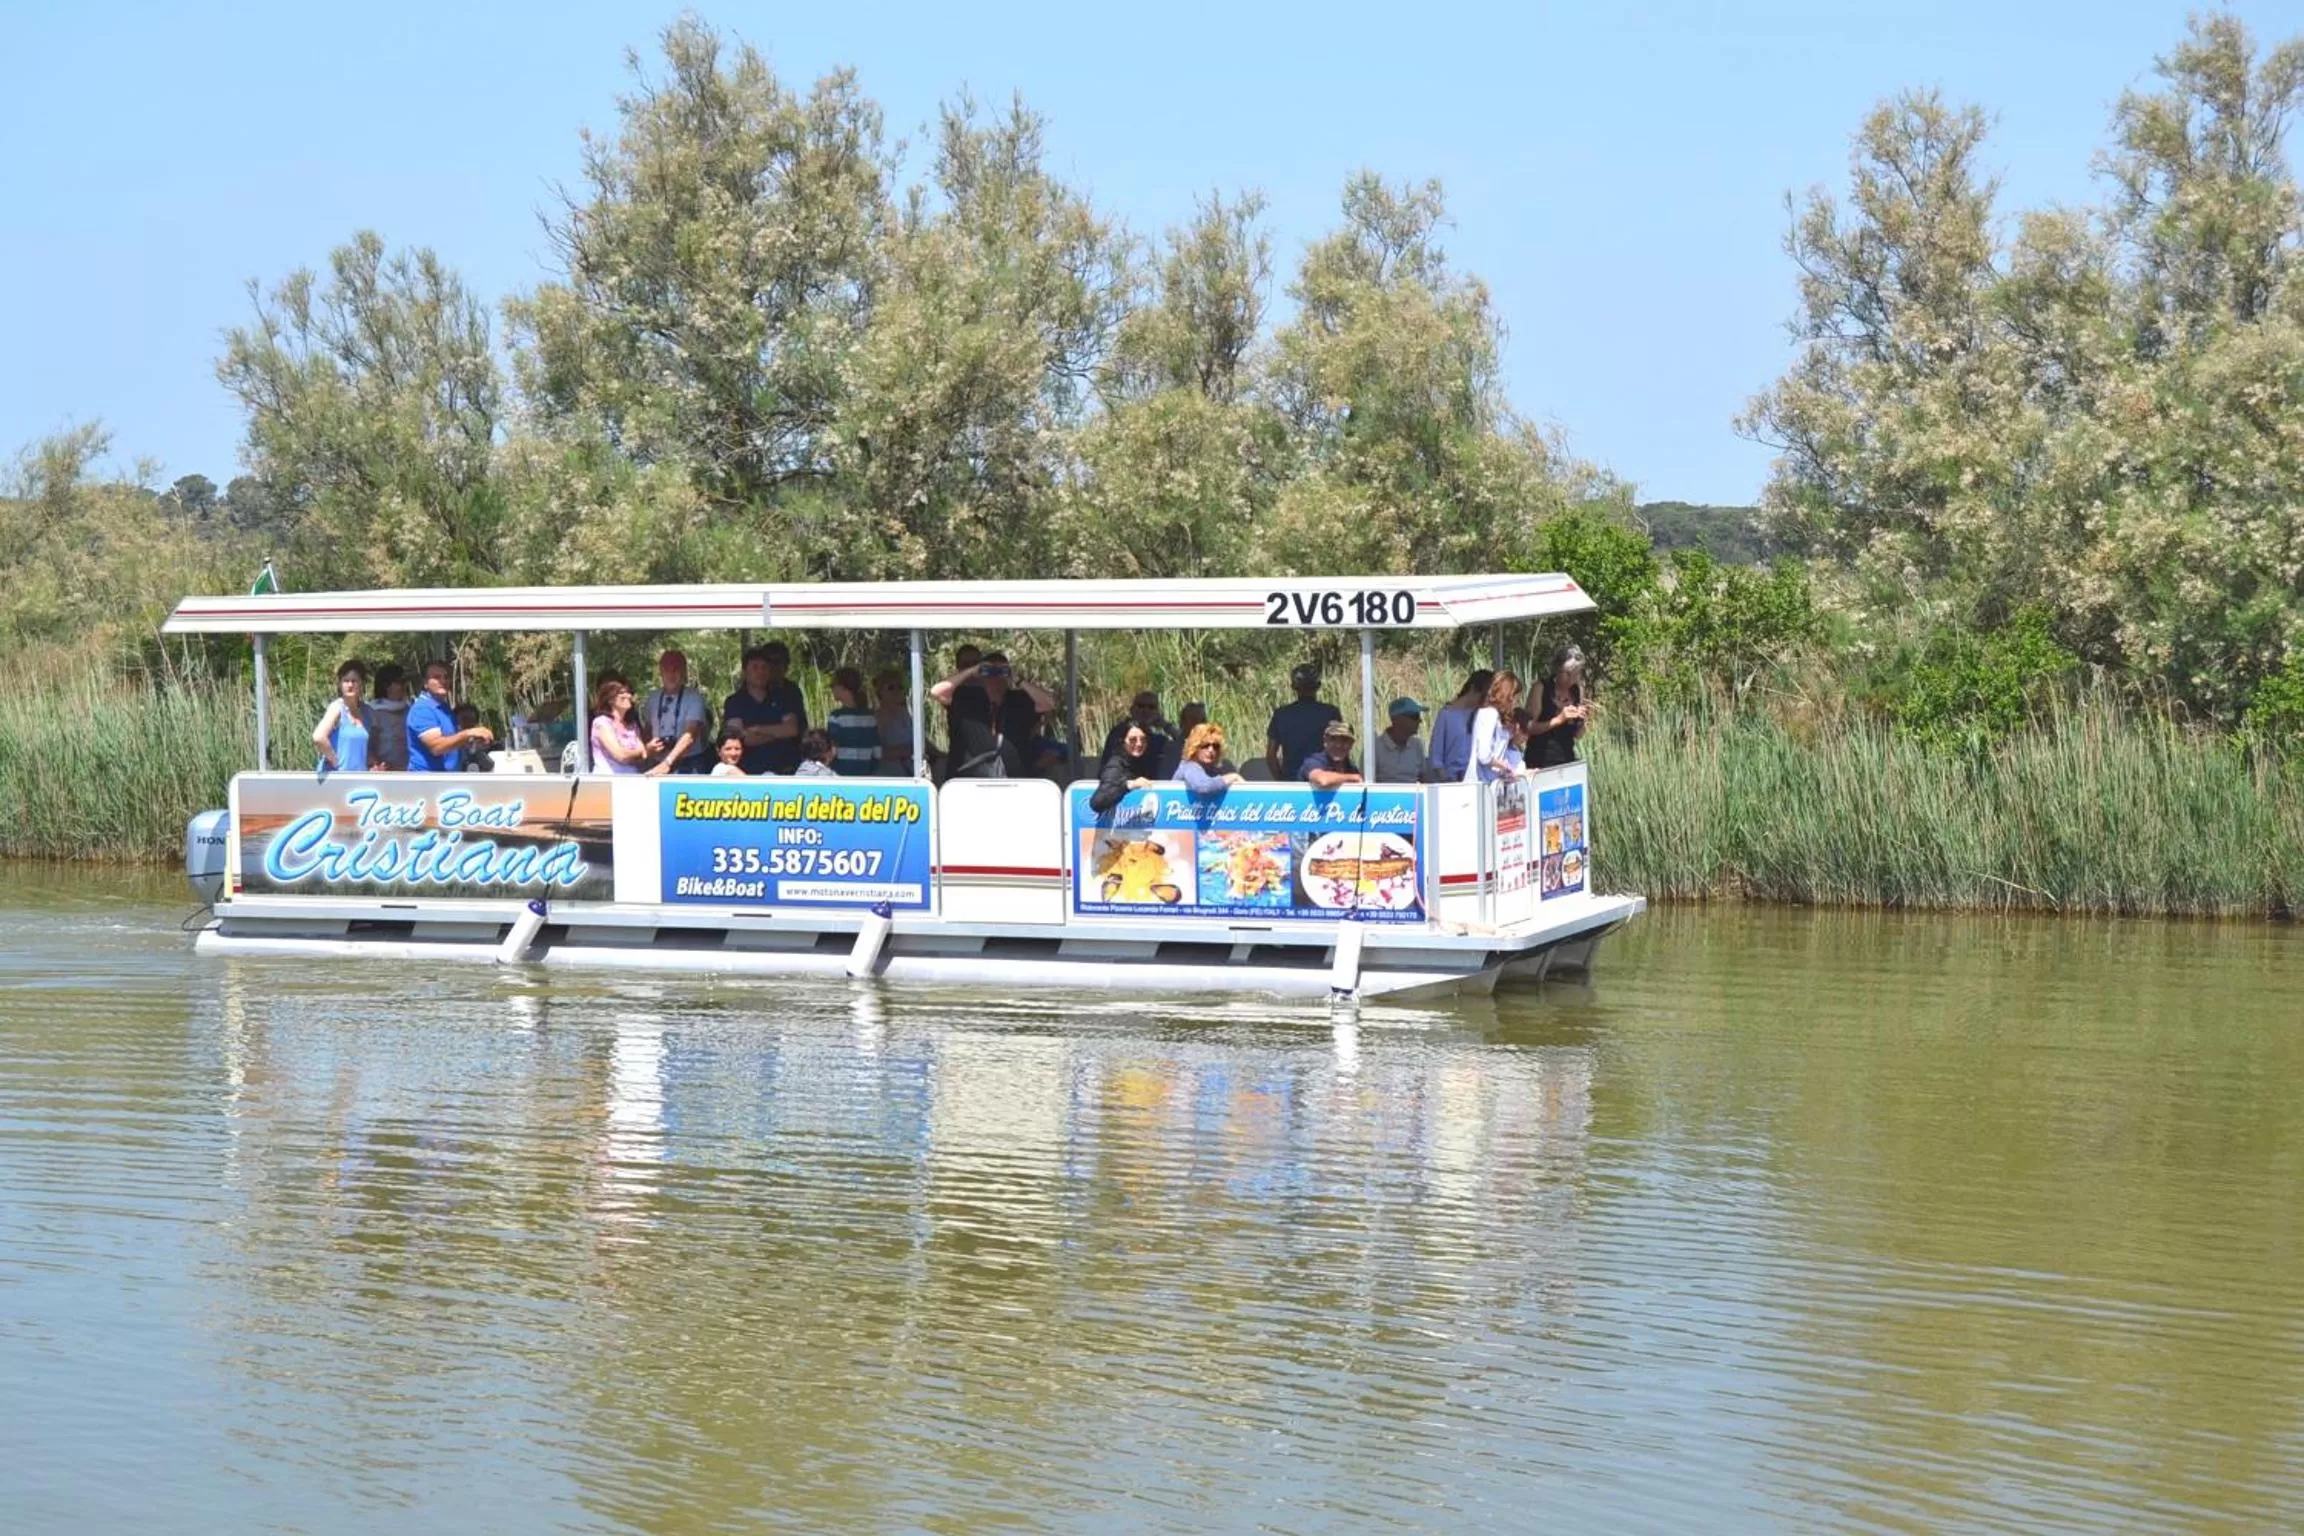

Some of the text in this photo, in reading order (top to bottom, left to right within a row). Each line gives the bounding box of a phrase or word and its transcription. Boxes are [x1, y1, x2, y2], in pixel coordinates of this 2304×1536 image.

[1266, 590, 1415, 625] 2V6180
[347, 789, 524, 828] Taxi Boat
[675, 793, 919, 823] Escursioni nel delta del Po
[1240, 803, 1263, 823] del
[1264, 803, 1296, 823] delta
[1324, 802, 1345, 825] Po
[197, 836, 226, 846] HON
[266, 810, 587, 885] Cristiana
[777, 827, 823, 845] INFO:
[712, 847, 883, 876] 335.5875607
[676, 877, 765, 898] Bike&Boat
